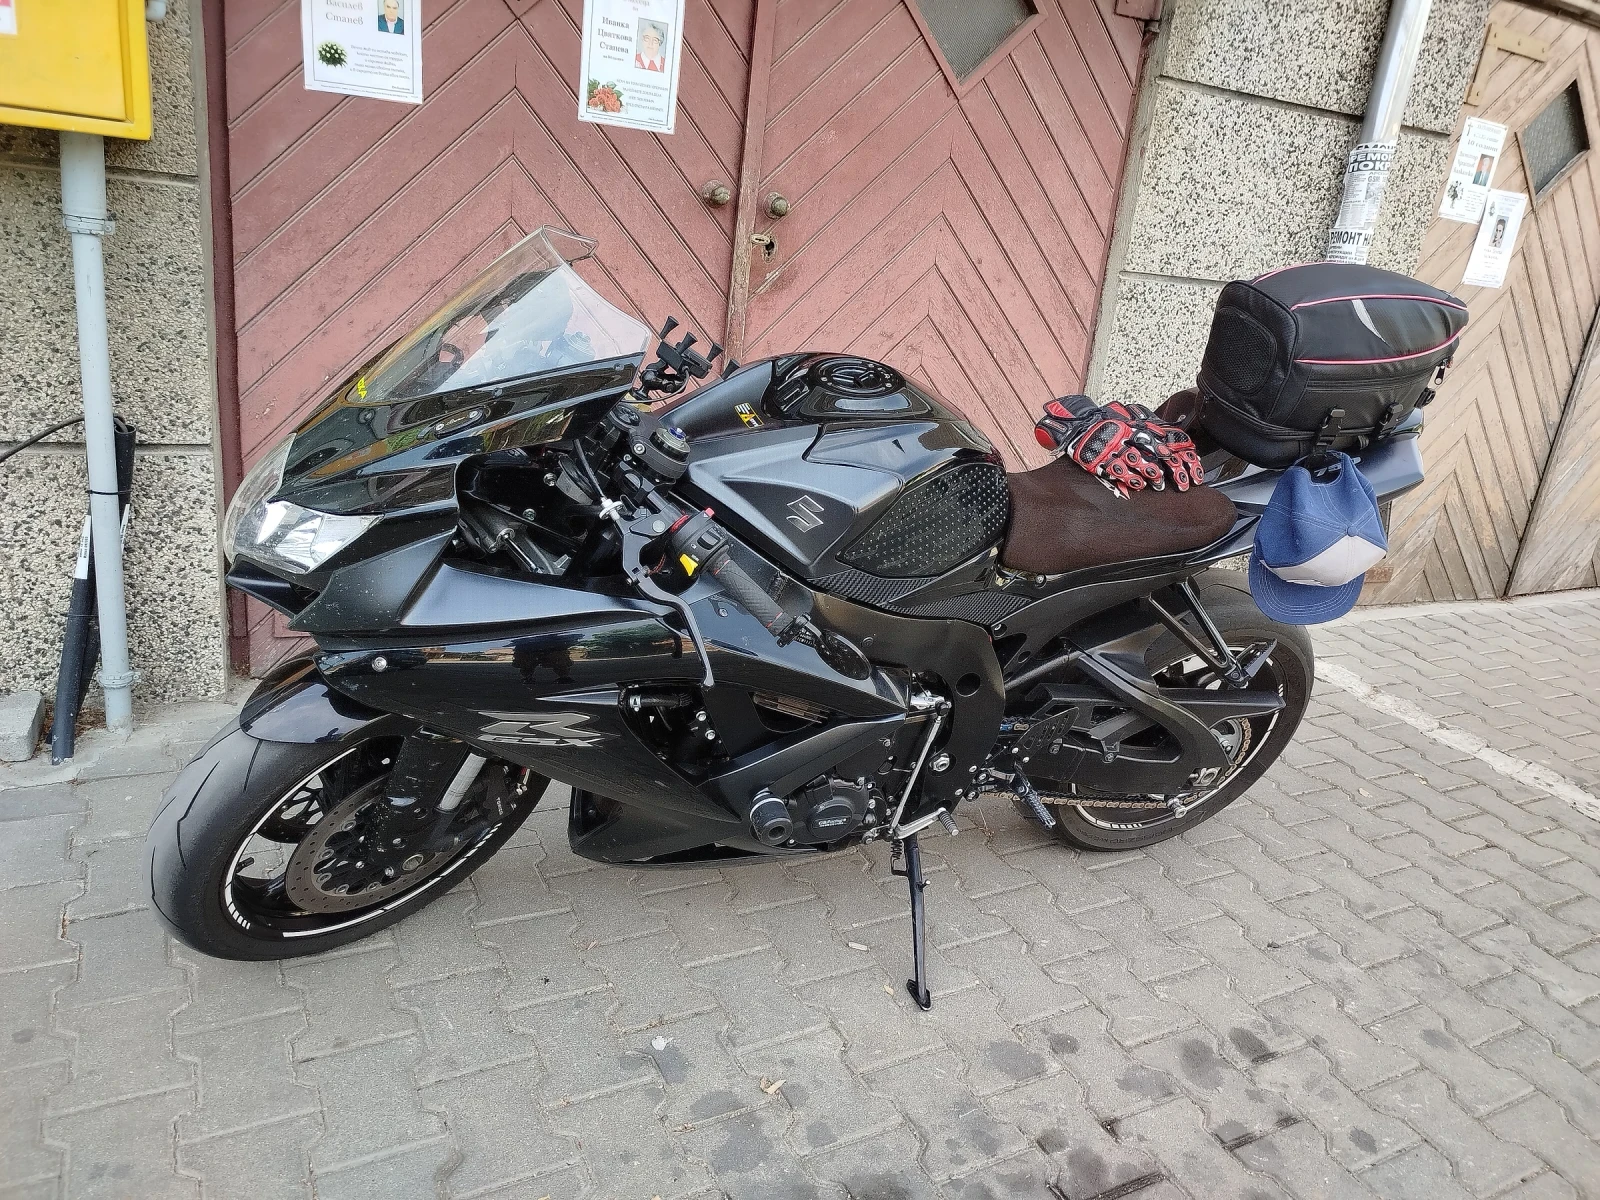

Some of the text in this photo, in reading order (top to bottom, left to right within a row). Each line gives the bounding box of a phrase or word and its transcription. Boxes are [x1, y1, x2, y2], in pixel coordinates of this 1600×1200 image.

[602, 16, 630, 29] Иванка
[599, 41, 629, 54] Станева
[1330, 231, 1362, 245] РЕМОНТ
